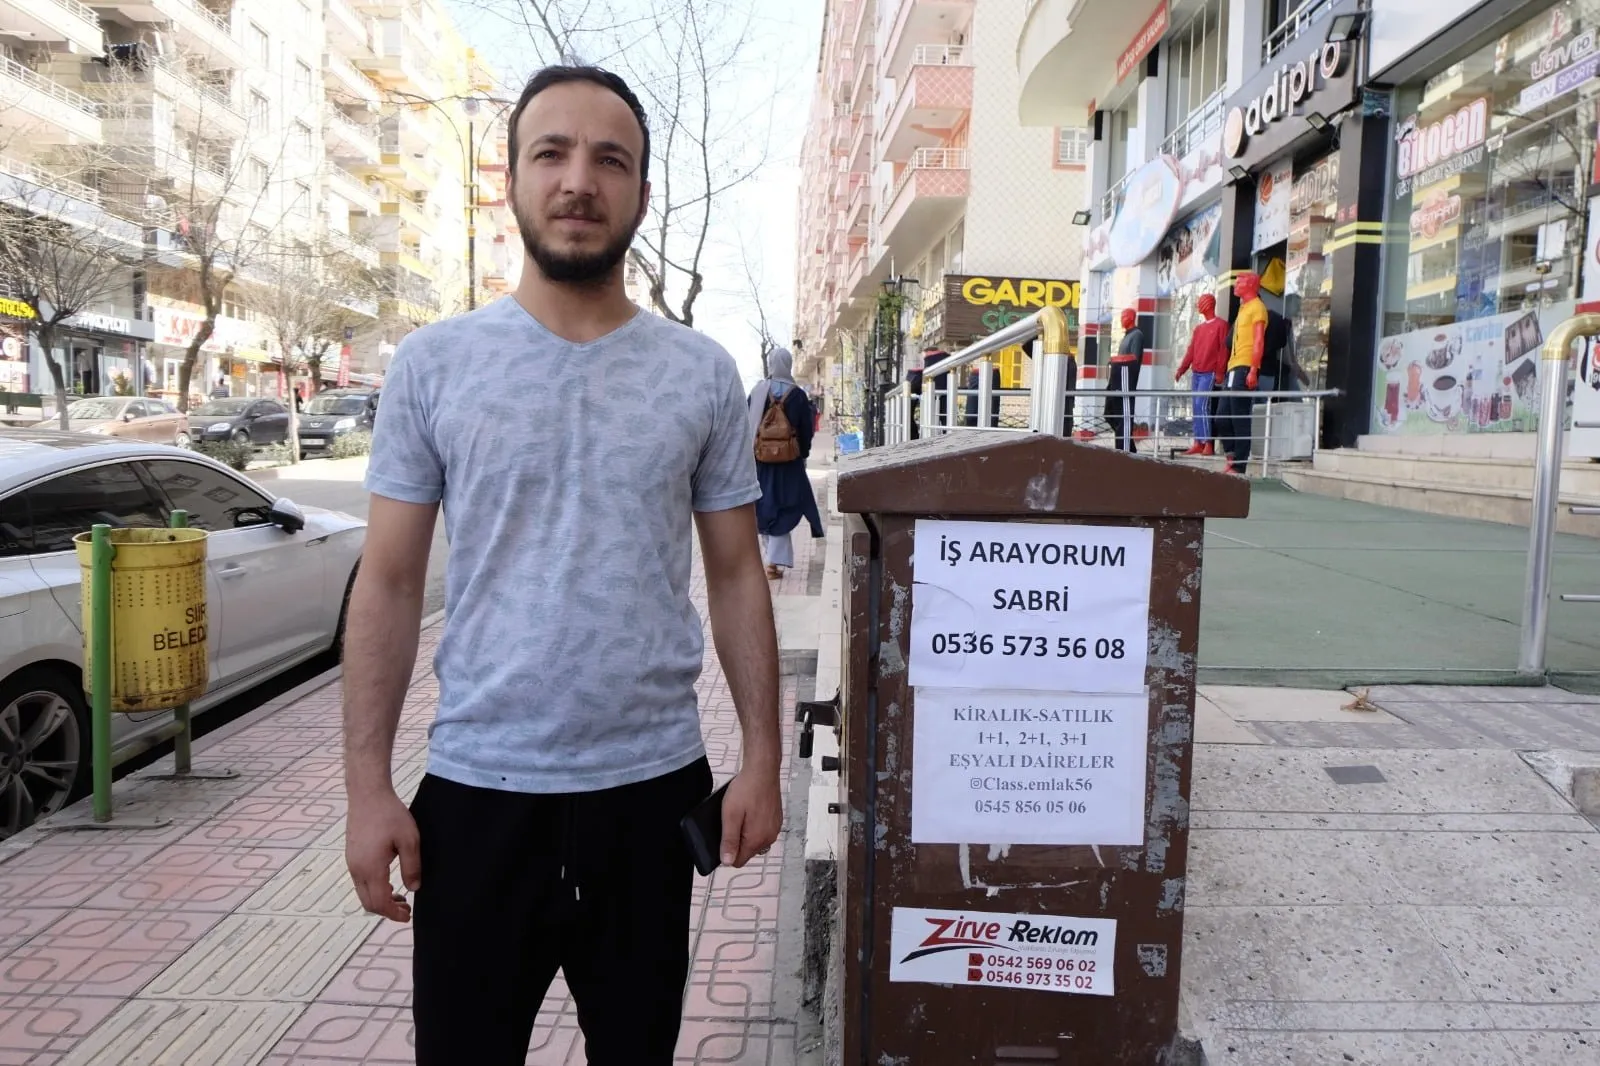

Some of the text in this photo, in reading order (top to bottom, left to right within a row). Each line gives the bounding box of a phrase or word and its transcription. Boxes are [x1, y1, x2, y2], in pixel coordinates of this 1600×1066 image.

[1245, 41, 1341, 136] adipro
[940, 535, 1126, 567] İŞ ARAYORUM
[992, 586, 1069, 612] SABRİ
[931, 632, 1125, 660] 0536 573 56 08
[953, 705, 1113, 723] KİRALIK-SATILIK
[978, 731, 1087, 748] 1+1, 2+1, 3+1
[949, 752, 1115, 771] EŞYALI DAİRELER
[974, 800, 1087, 814] 0545 856 05 06
[919, 915, 1098, 948] Zirve Reklam
[987, 954, 1096, 973] 0542 569 06 02
[986, 970, 1093, 989] 0546 973 35 02
